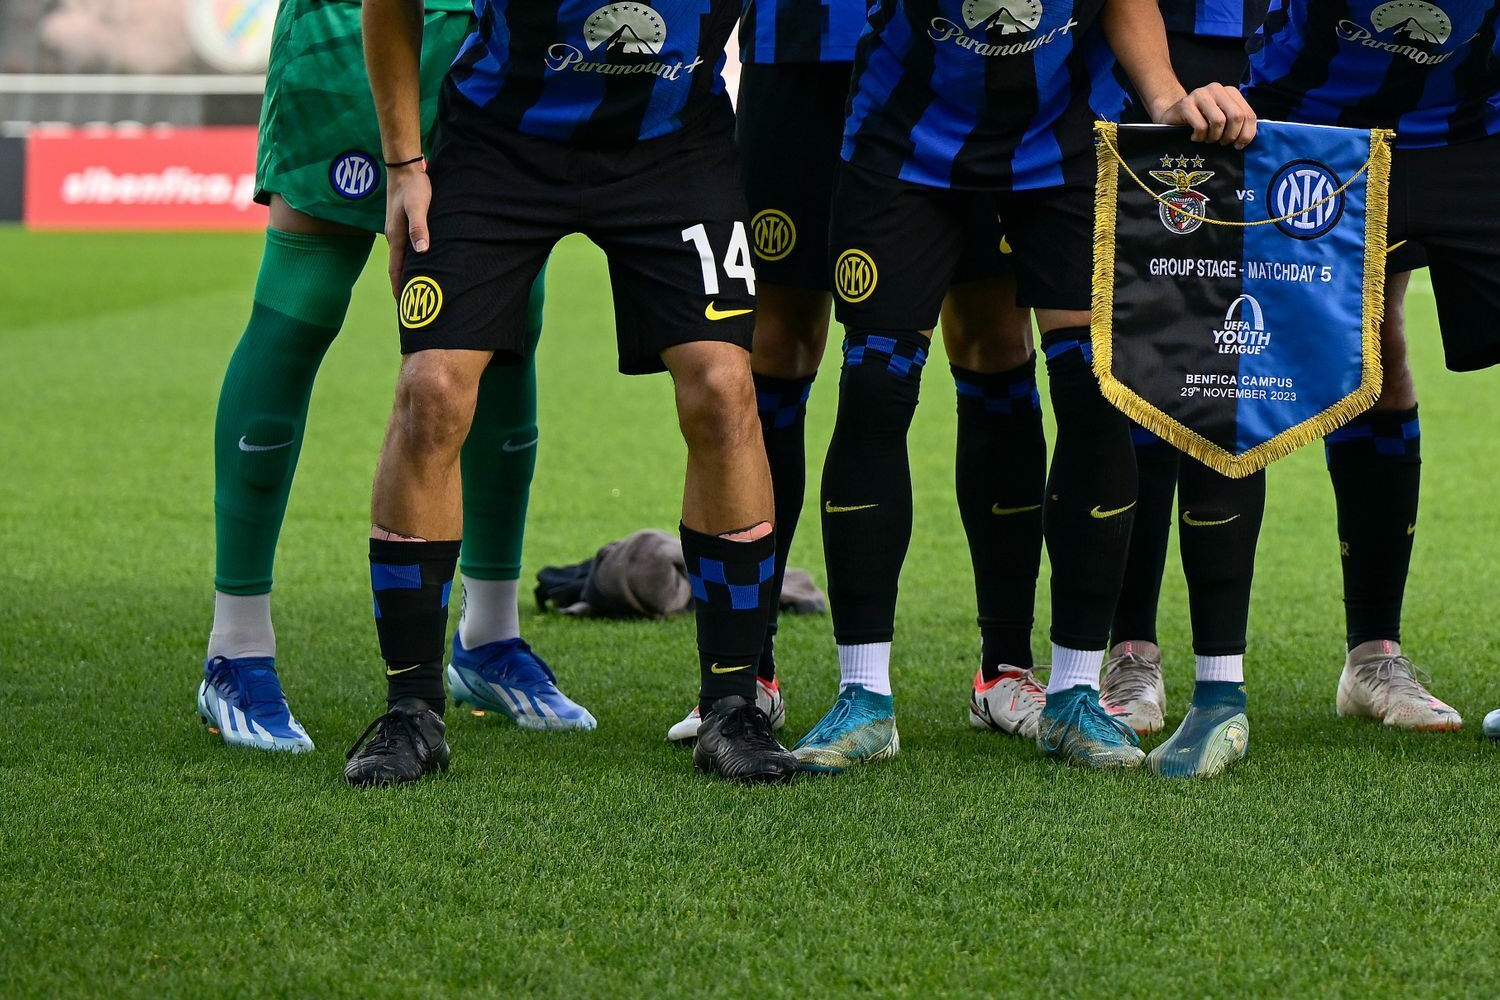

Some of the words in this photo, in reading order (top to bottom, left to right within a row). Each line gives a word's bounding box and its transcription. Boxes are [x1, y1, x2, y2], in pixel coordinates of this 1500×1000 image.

[927, 17, 1078, 56] Paramount+
[544, 43, 704, 81] Paramount+
[681, 221, 756, 296] 14
[1149, 257, 1195, 277] GROUP
[1196, 258, 1237, 278] STAGE
[1247, 261, 1316, 283] MATCHDAY
[1319, 265, 1333, 283] 5
[1223, 320, 1250, 331] UEFA
[1212, 330, 1271, 346] YOUTH
[1185, 374, 1238, 386] BENFICA
[1241, 375, 1293, 388] CAMPUS
[1202, 387, 1268, 400] NOVEMBER
[1270, 389, 1297, 401] 2023
